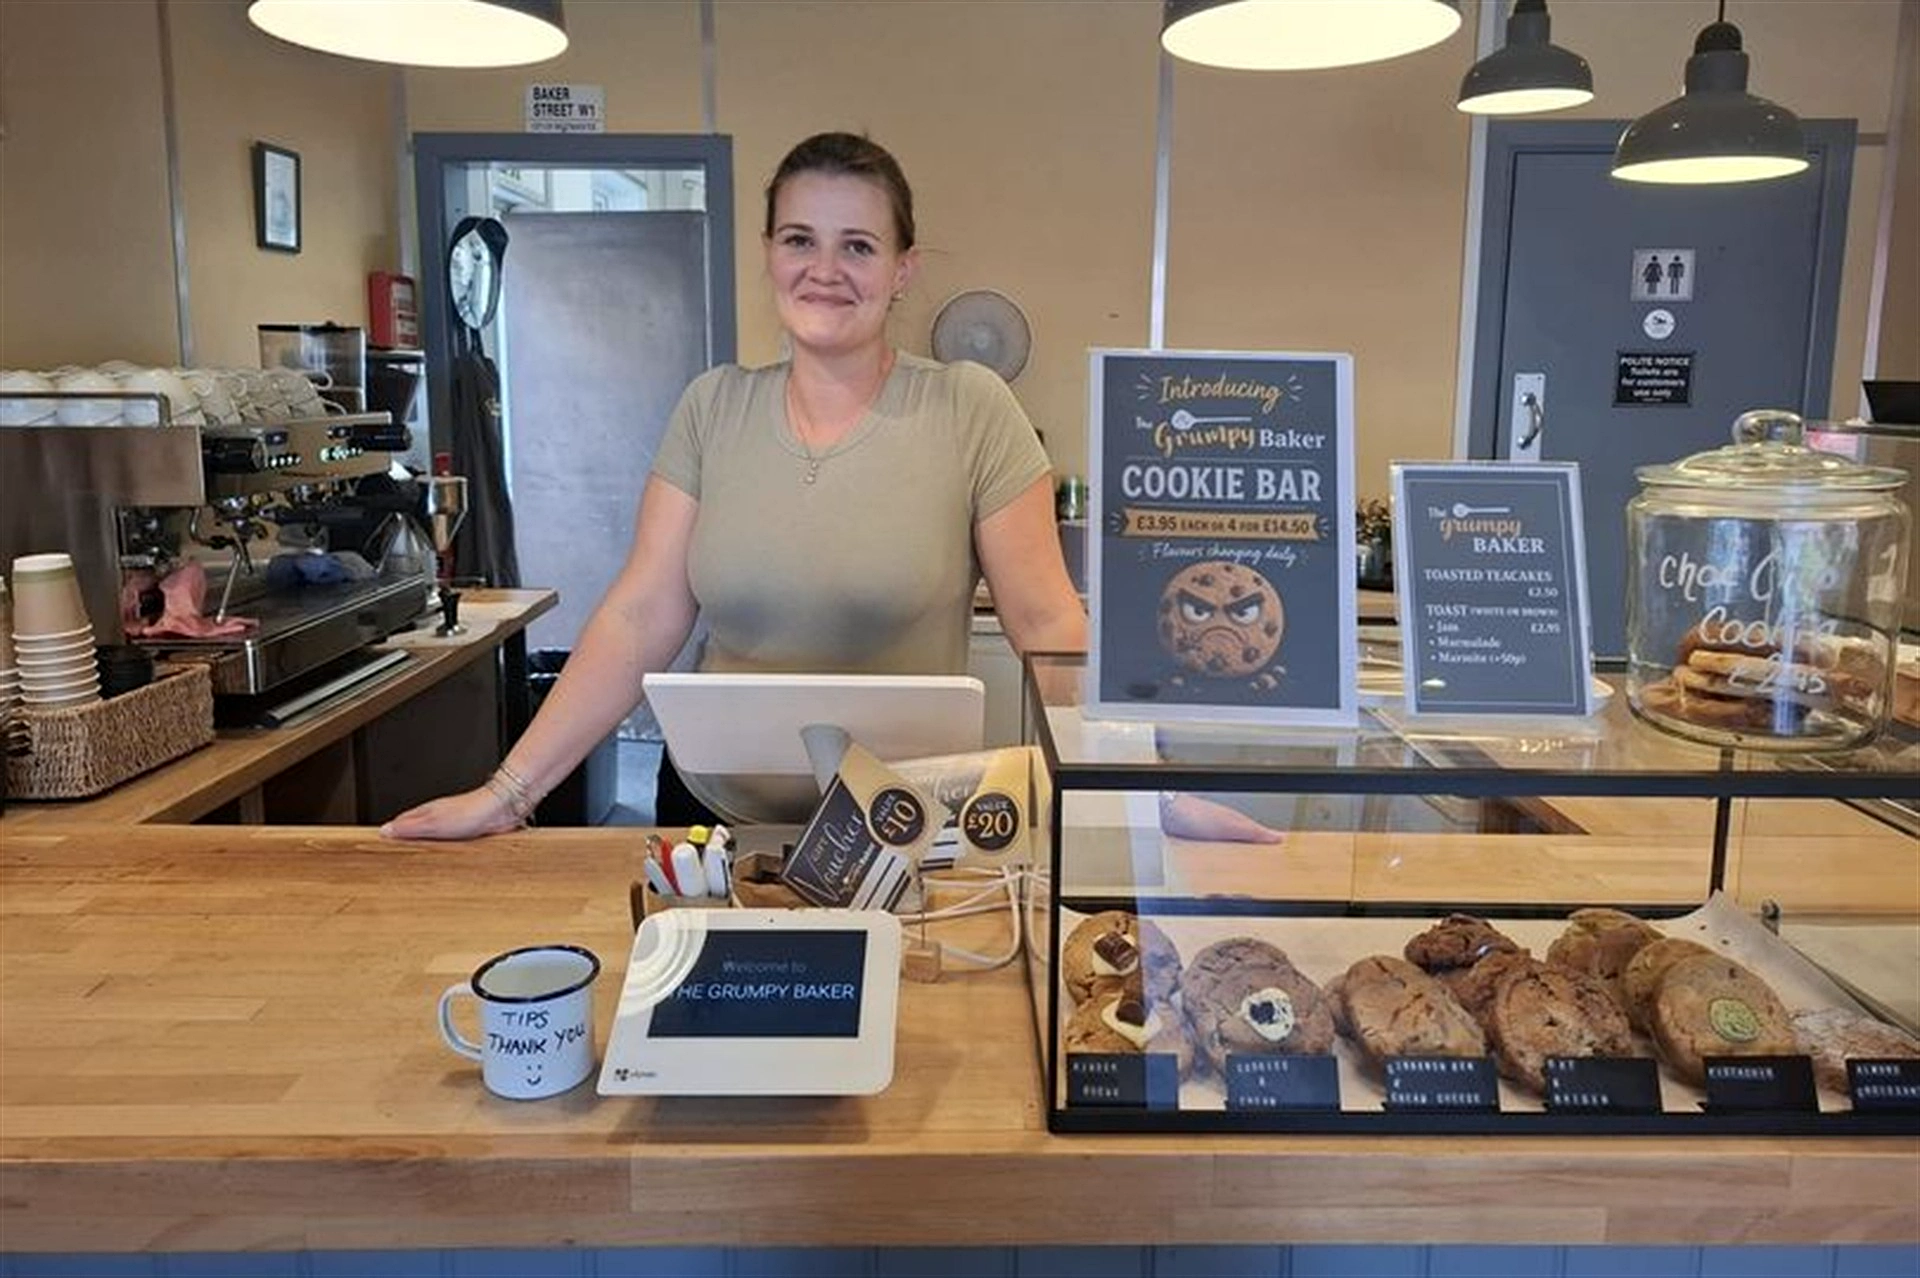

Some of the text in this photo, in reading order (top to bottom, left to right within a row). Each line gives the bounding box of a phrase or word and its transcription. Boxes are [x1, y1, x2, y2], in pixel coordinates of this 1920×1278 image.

[533, 86, 570, 100] BAKER
[533, 103, 595, 117] STREET W1
[1621, 357, 1689, 366] POLITE NOTICE
[1621, 377, 1634, 386] for
[1159, 374, 1283, 413] Introducing
[1155, 421, 1255, 457] Grumpy
[1259, 429, 1326, 449] Baker
[1122, 465, 1321, 502] COOKIE BAR
[1428, 507, 1446, 518] The
[1137, 516, 1310, 535] £3.95 EACH OR 4 FOR £14.50
[1440, 518, 1521, 541] grumpy
[1473, 537, 1545, 553] BAKER
[1207, 542, 1263, 563] changing
[1266, 544, 1298, 568] daily
[1424, 568, 1553, 582] TOASTED TEACAKES
[1528, 587, 1558, 598] £2.50
[1425, 604, 1467, 617] TOAST
[1437, 620, 1459, 633] Jam
[1438, 636, 1500, 648] Marmalade
[1438, 652, 1486, 663] Marmite
[881, 800, 916, 839] £10
[967, 811, 1013, 838] £20
[793, 813, 864, 902] Voucher
[723, 961, 807, 973] Welcome to
[707, 983, 789, 999] GRUMPY
[793, 983, 855, 1000] BAKER
[502, 1010, 549, 1029] TIPS
[488, 1033, 548, 1055] THANK
